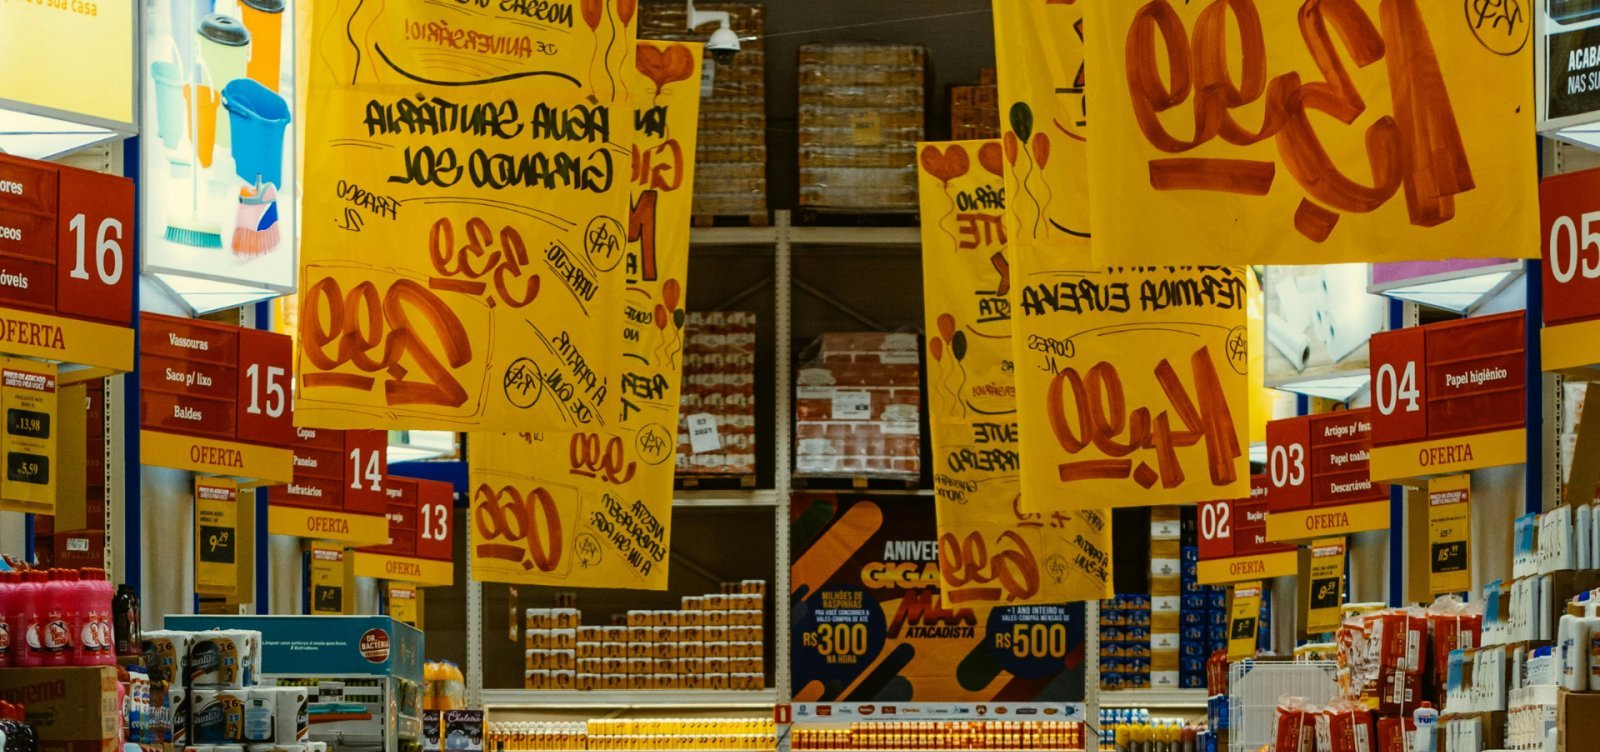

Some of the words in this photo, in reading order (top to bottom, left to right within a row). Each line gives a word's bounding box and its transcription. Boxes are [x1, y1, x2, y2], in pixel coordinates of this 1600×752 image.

[1567, 75, 1587, 95] NAS
[69, 213, 123, 286] 16
[169, 332, 209, 351] Vassouras
[166, 368, 185, 382] Saco
[186, 371, 196, 386] p/
[197, 372, 212, 387] lixo
[1446, 373, 1469, 388] Papel
[1470, 366, 1508, 385] higiênico
[246, 363, 285, 418] 15
[1375, 360, 1420, 416] 04
[173, 405, 202, 421] Baldes
[20, 417, 41, 432] 13,98
[296, 426, 317, 439] Copos
[1324, 424, 1348, 438] Artigos
[1349, 421, 1357, 435] p/
[190, 444, 244, 468] OFERTA
[293, 455, 318, 468] Panelas
[1330, 453, 1349, 468] Papel
[1419, 443, 1474, 468] OFERTA
[21, 461, 39, 476] 5,59
[350, 447, 382, 492] 14
[1270, 443, 1305, 488] 03
[287, 483, 323, 497] Refratários
[1330, 479, 1372, 494] Descartáveis
[307, 515, 350, 534] OFERTA
[421, 503, 448, 541] 13
[1201, 501, 1230, 540] 02
[1306, 511, 1350, 530] OFERTA
[385, 560, 421, 577] OFERTA
[1230, 560, 1265, 576] OFERTA
[905, 626, 974, 638] ATACADISTA
[158, 643, 172, 652] 16
[219, 643, 234, 652] 16
[224, 700, 239, 710] 16
